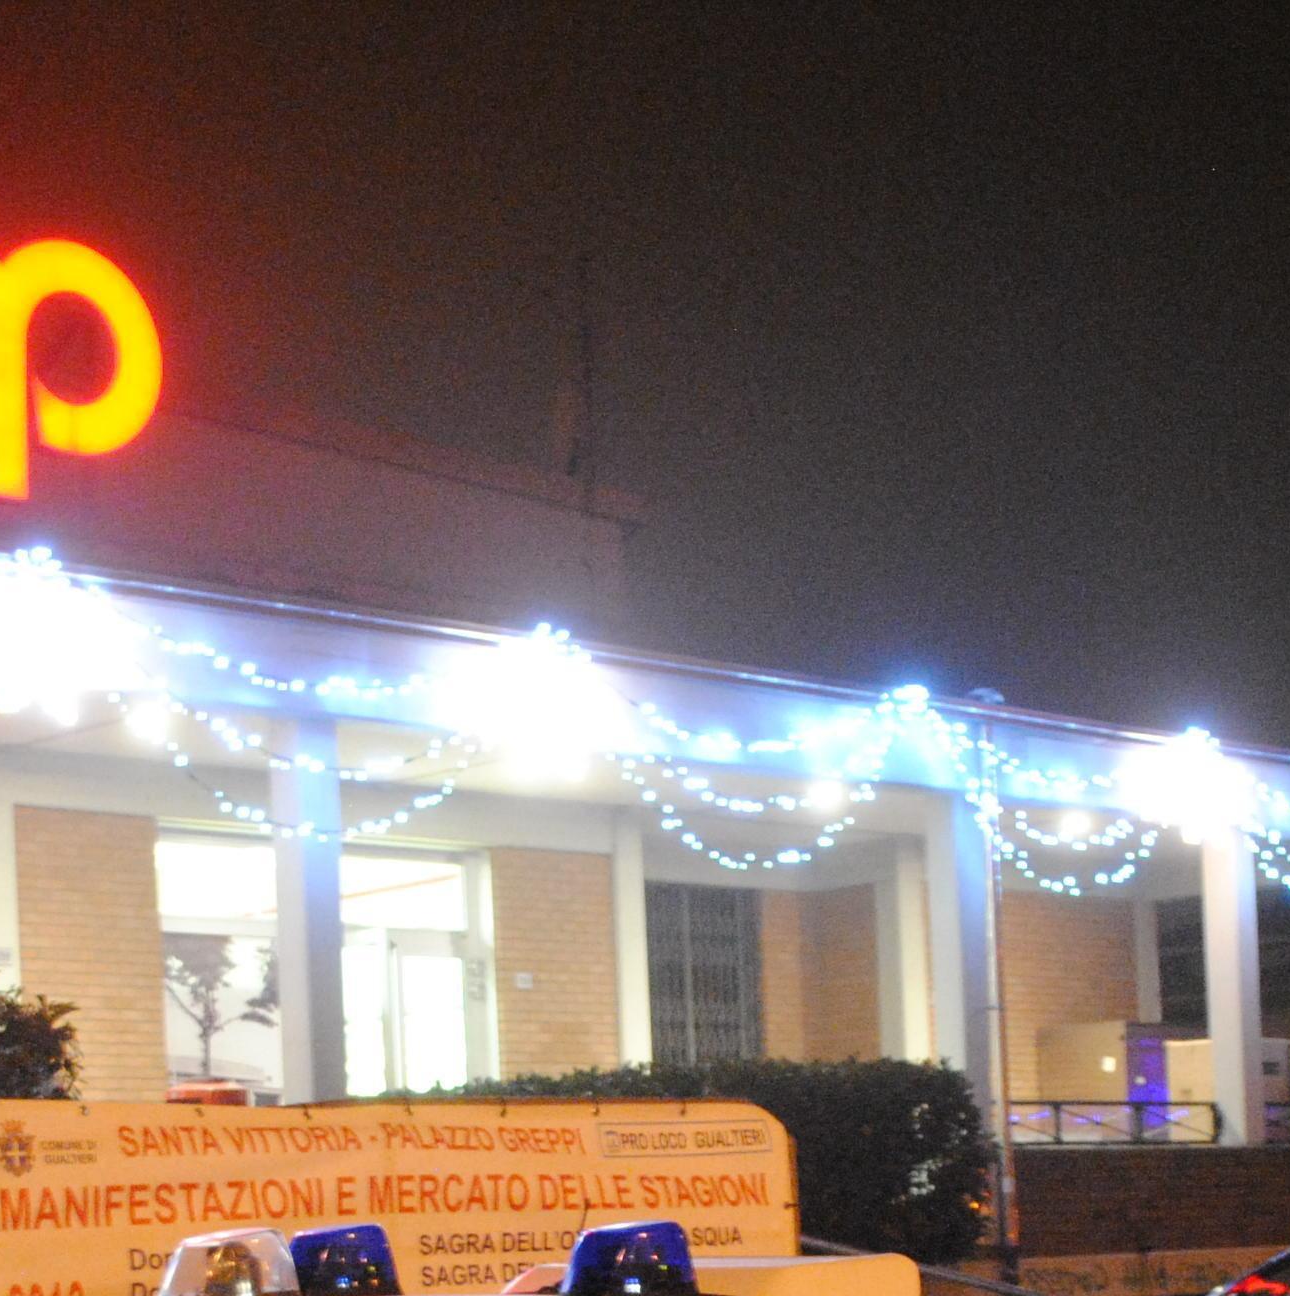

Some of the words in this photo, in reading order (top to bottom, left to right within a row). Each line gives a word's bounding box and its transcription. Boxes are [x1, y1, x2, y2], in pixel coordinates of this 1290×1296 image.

[40, 1139, 86, 1151] COMUNE
[117, 1125, 219, 1157] SANTA
[222, 1125, 362, 1153] VITTORIA
[378, 1122, 495, 1151] PALAZZO
[497, 1126, 587, 1155] GREPPI
[620, 1132, 649, 1150] PRO
[652, 1132, 687, 1151] LOCO
[694, 1128, 767, 1149] GUALTIERI
[44, 1153, 98, 1165] GUALTIERI
[336, 1176, 357, 1216] E
[368, 1173, 530, 1215] MERCATO
[537, 1173, 635, 1212] DELLE
[639, 1171, 770, 1209] STAGIONI
[419, 1230, 496, 1256] SAGRA
[502, 1230, 576, 1253] DELL'O
[690, 1225, 743, 1248] SQUA
[421, 1262, 498, 1287] SAGRA
[501, 1261, 537, 1283] DE
